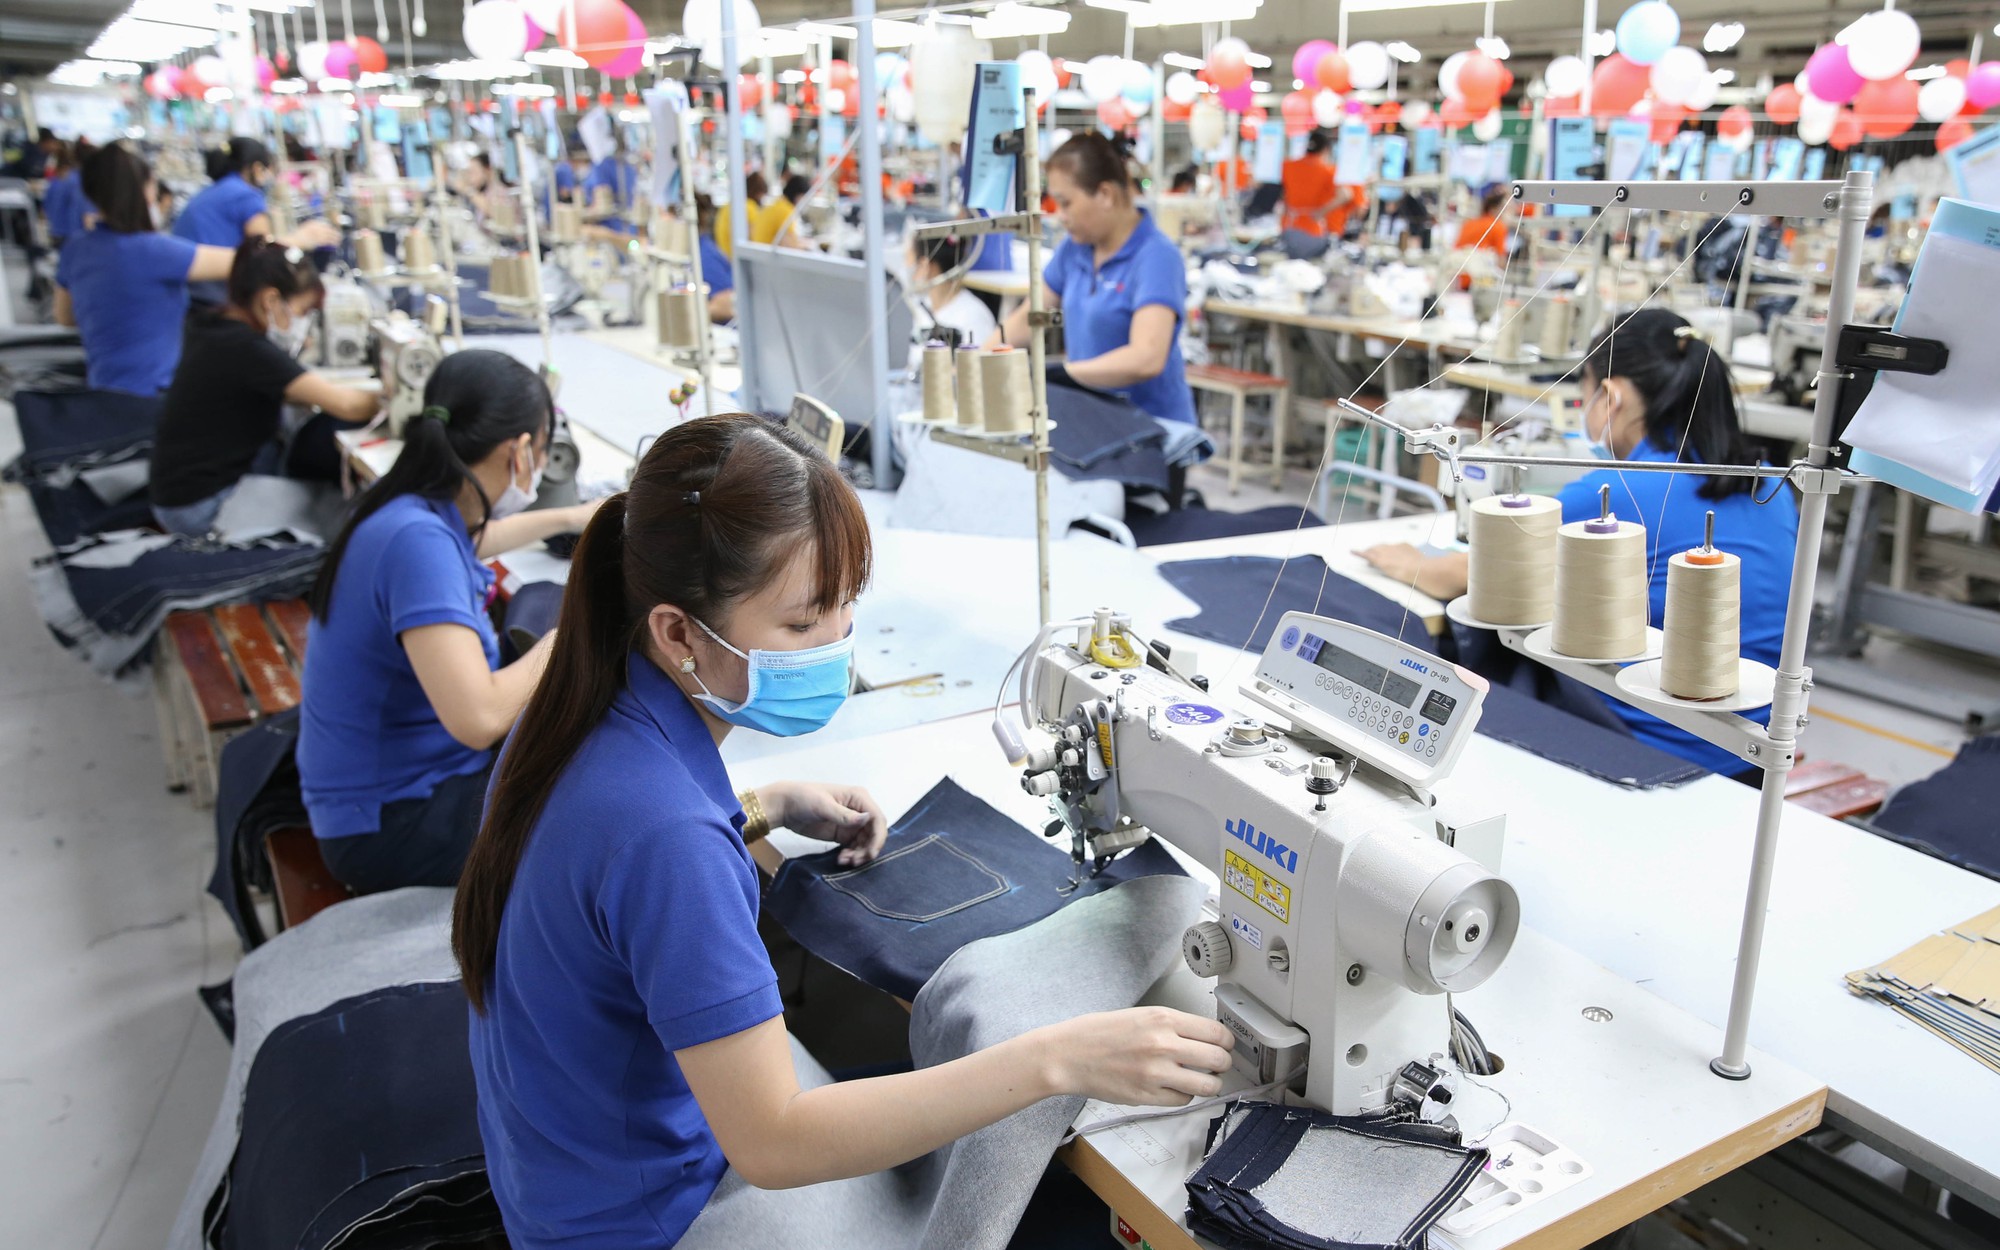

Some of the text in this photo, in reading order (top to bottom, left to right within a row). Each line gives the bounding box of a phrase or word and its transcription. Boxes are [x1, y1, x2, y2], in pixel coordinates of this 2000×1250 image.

[1400, 659, 1428, 674] JUKI
[1176, 706, 1212, 721] 240
[1225, 818, 1298, 874] JUKI
[1120, 1221, 1131, 1235] OFF
